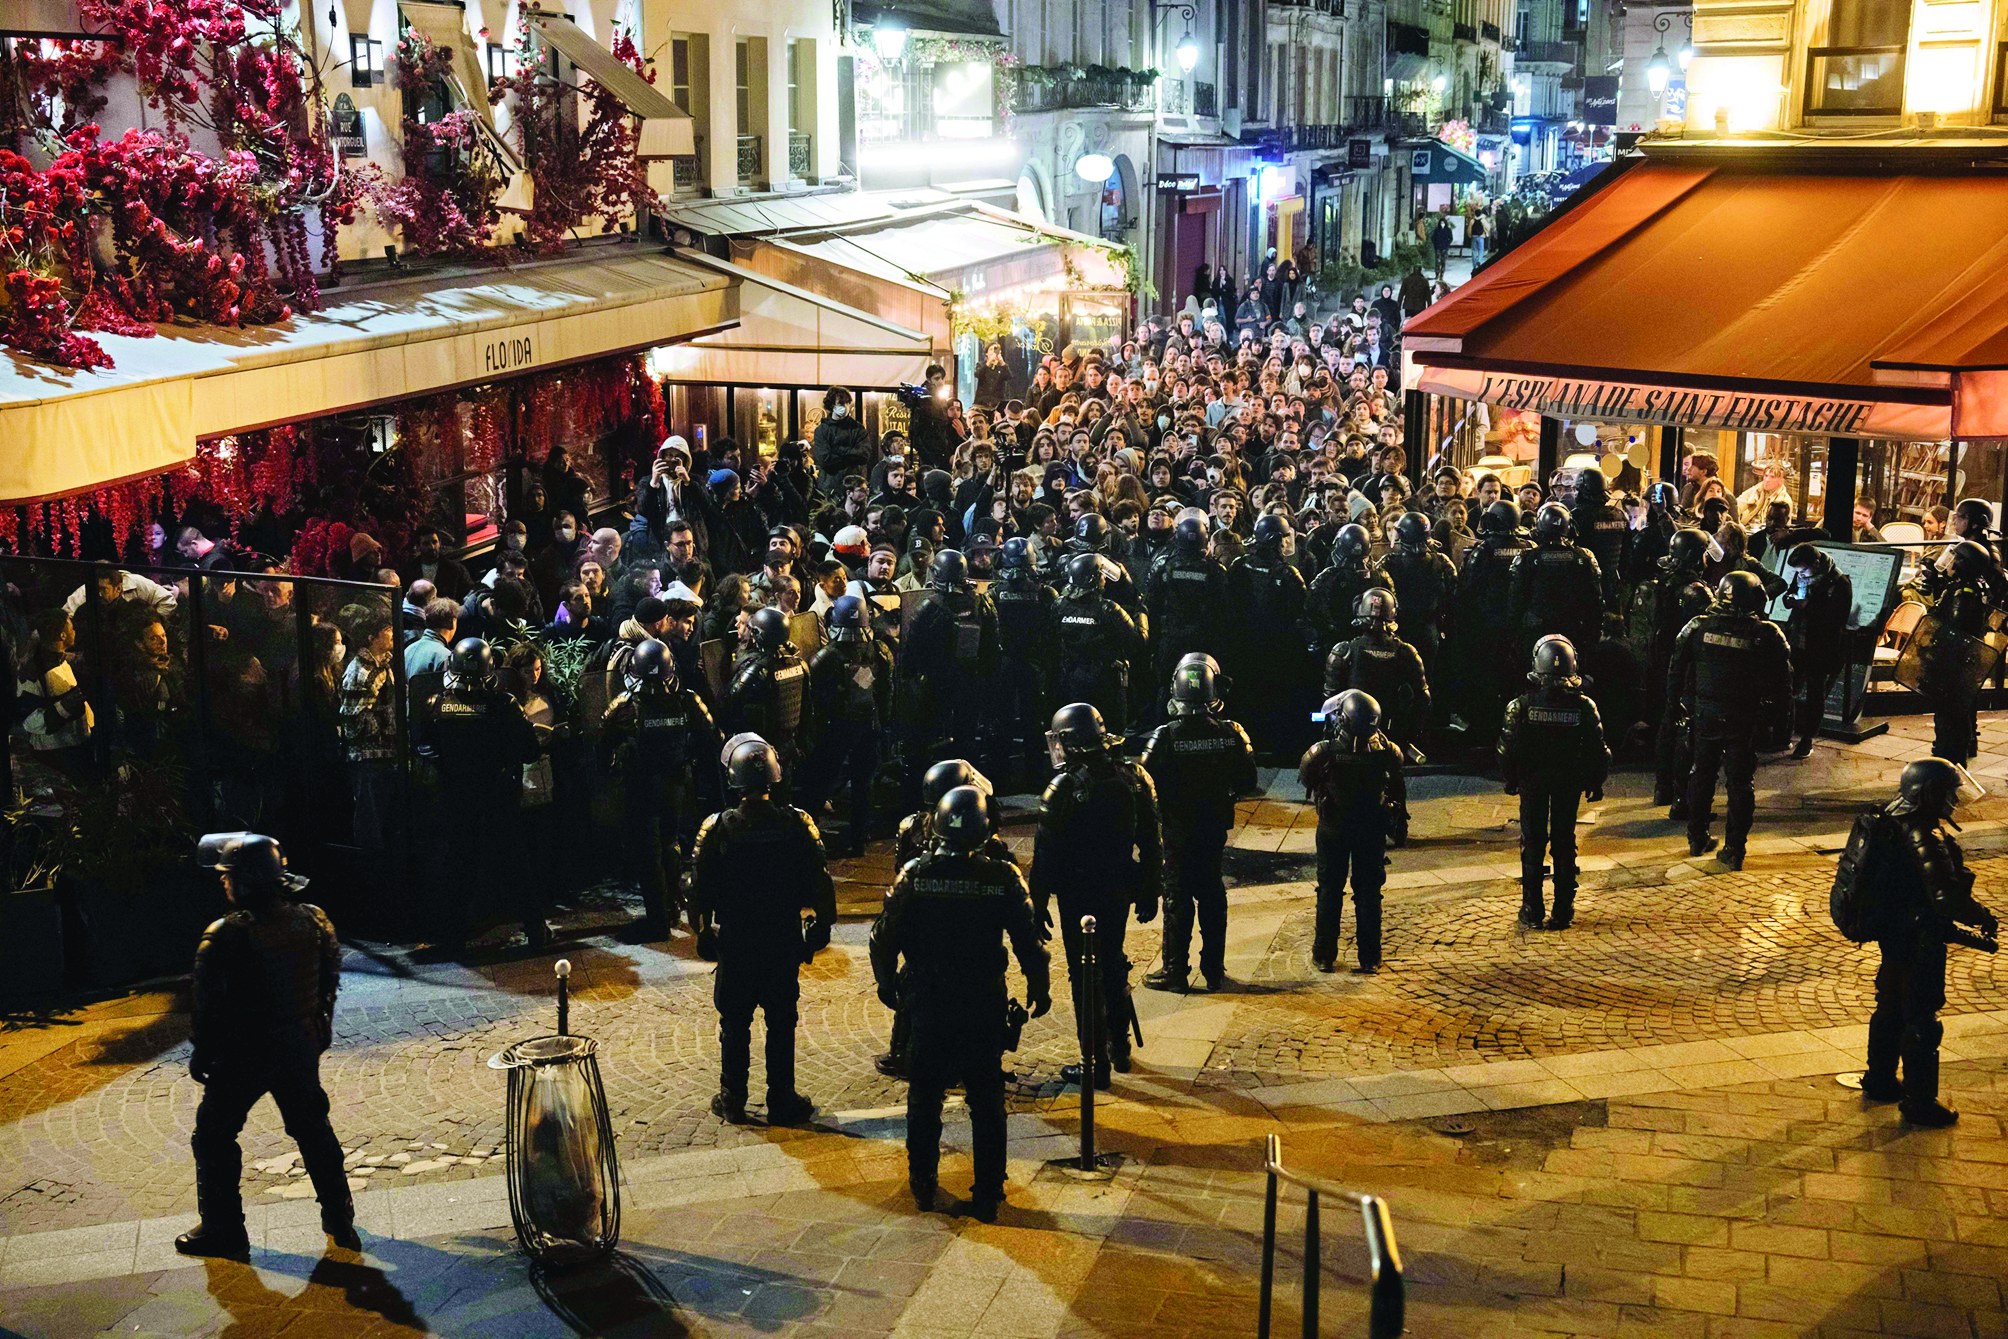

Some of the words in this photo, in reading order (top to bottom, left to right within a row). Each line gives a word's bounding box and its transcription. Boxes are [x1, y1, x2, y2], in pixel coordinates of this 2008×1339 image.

[340, 122, 352, 132] RUE
[1478, 377, 1640, 418] L'ESPLANADE
[1637, 389, 1725, 425] SAINT
[1721, 396, 1874, 434] EUSTACHE
[644, 716, 685, 728] GENDARMERIE
[1528, 709, 1580, 723] GENDARMERIE
[1173, 737, 1225, 752] GENDARMERIE
[913, 877, 980, 895] GENDARMERIE
